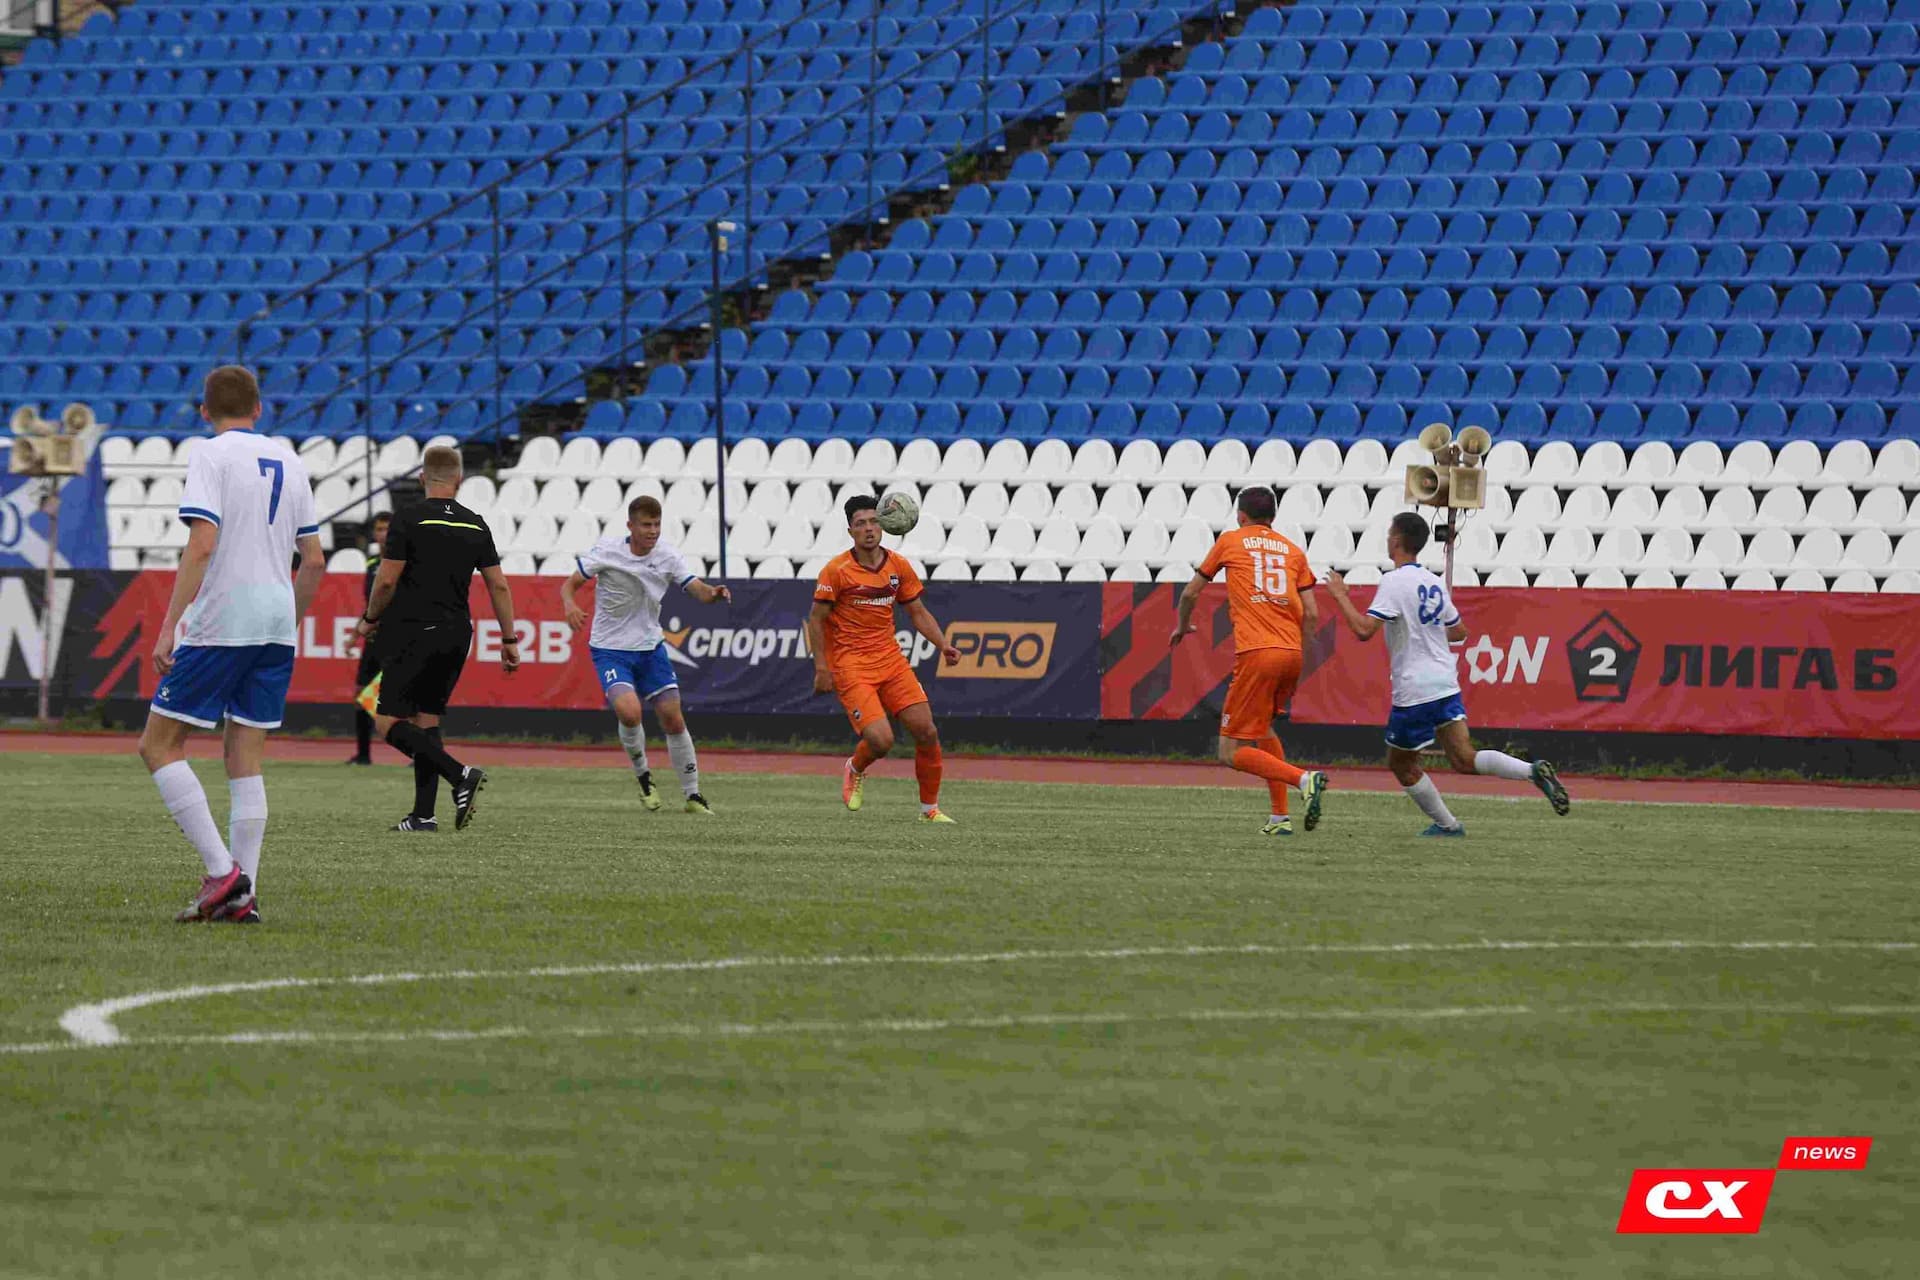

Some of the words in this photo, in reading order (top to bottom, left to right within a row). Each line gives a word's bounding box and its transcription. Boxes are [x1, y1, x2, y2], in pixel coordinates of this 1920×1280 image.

[257, 457, 284, 525] 7
[1248, 550, 1288, 595] 15
[949, 632, 1044, 668] PRO
[1588, 647, 1618, 676] 2
[1659, 644, 1839, 691] ЛИГА
[1853, 648, 1898, 692] Б
[604, 668, 618, 683] 21
